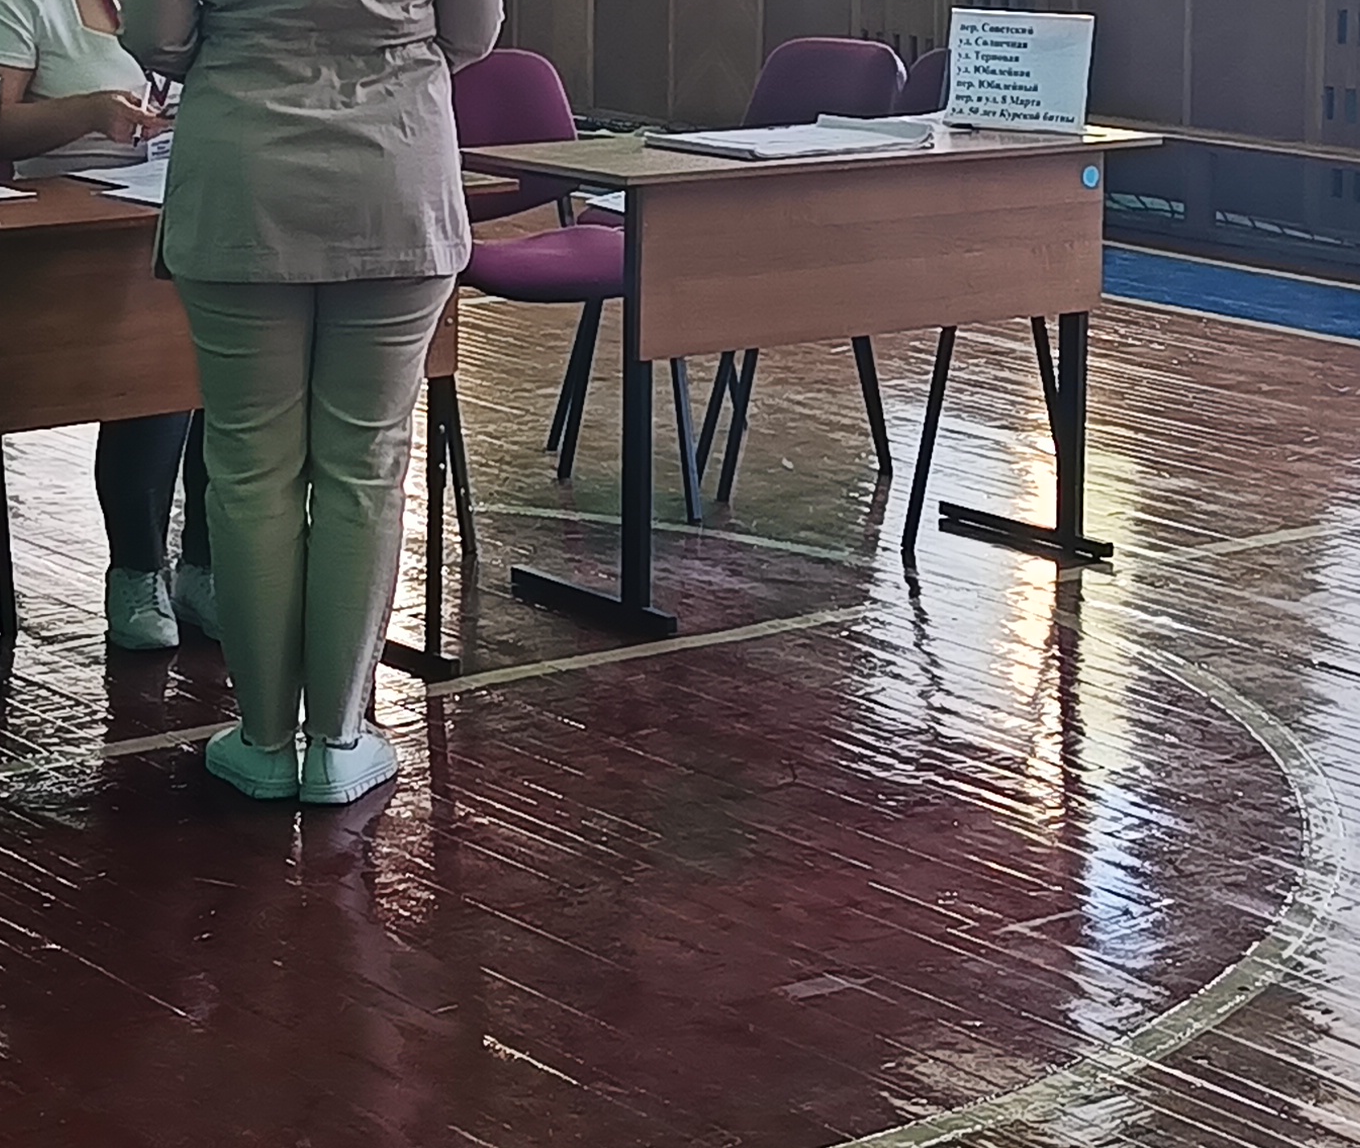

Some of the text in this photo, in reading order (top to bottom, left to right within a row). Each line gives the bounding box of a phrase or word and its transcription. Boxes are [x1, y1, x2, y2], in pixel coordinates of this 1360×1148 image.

[982, 23, 1034, 35] Советский
[975, 37, 1028, 48] Солнечная
[1001, 95, 1007, 104] 8
[1009, 95, 1041, 108] Марта
[999, 109, 1040, 121] Курской
